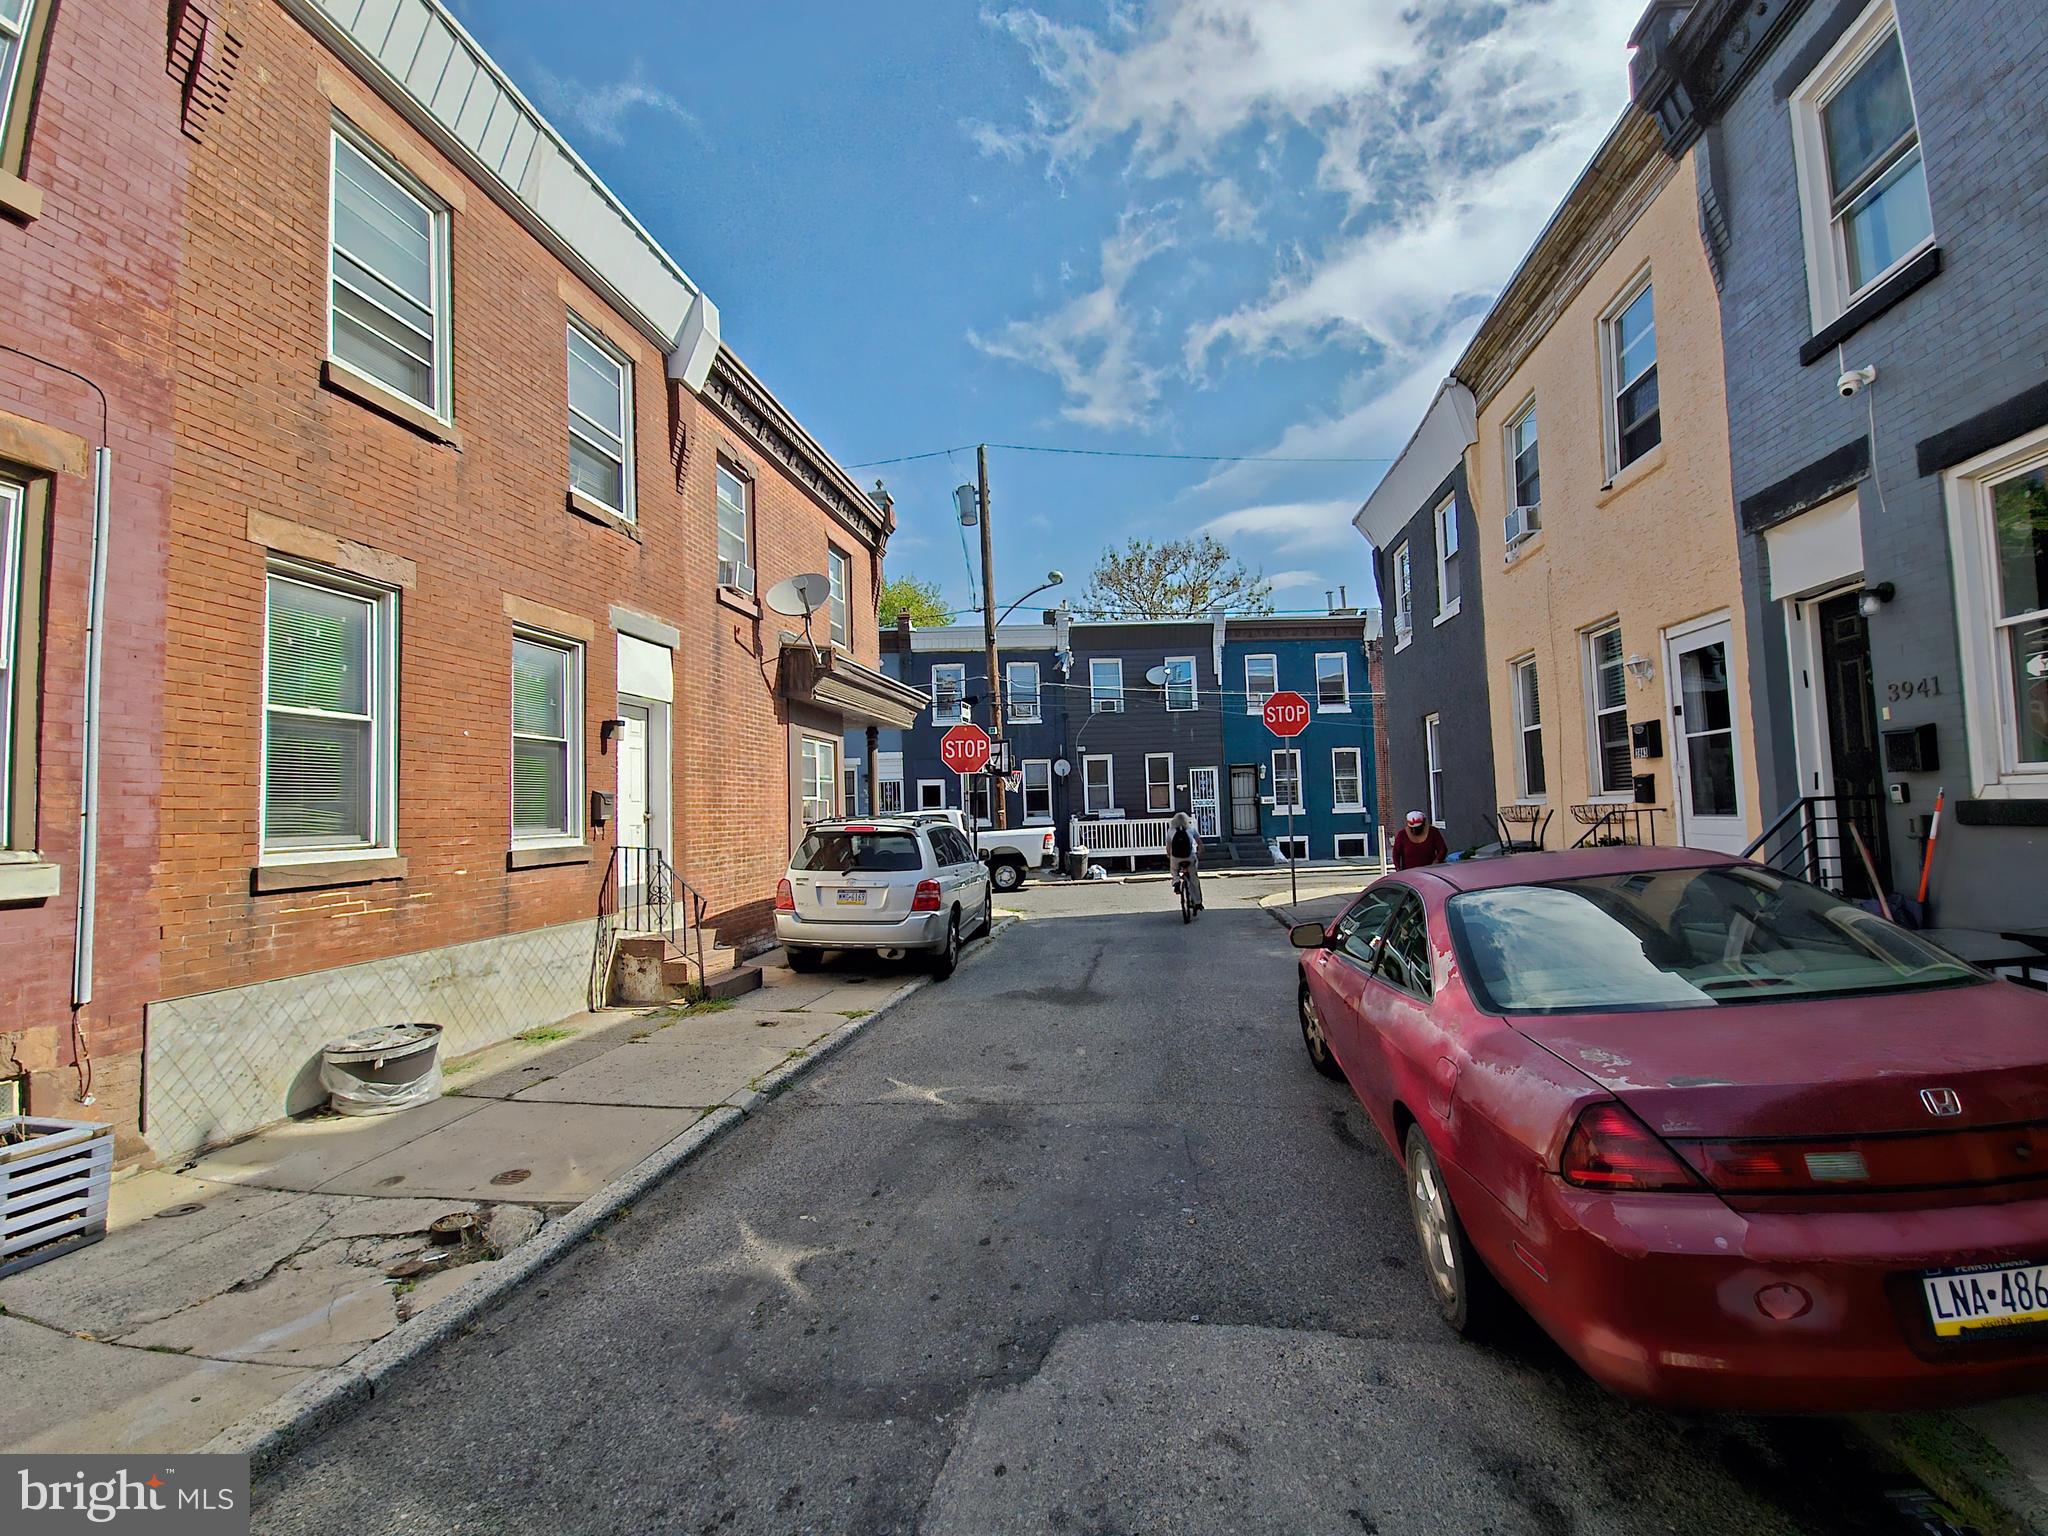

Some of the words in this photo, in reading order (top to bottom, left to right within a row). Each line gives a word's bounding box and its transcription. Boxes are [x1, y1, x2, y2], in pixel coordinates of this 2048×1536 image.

[1887, 675, 1945, 703] 3941
[1266, 705, 1307, 723] STOP
[945, 740, 987, 759] STOP
